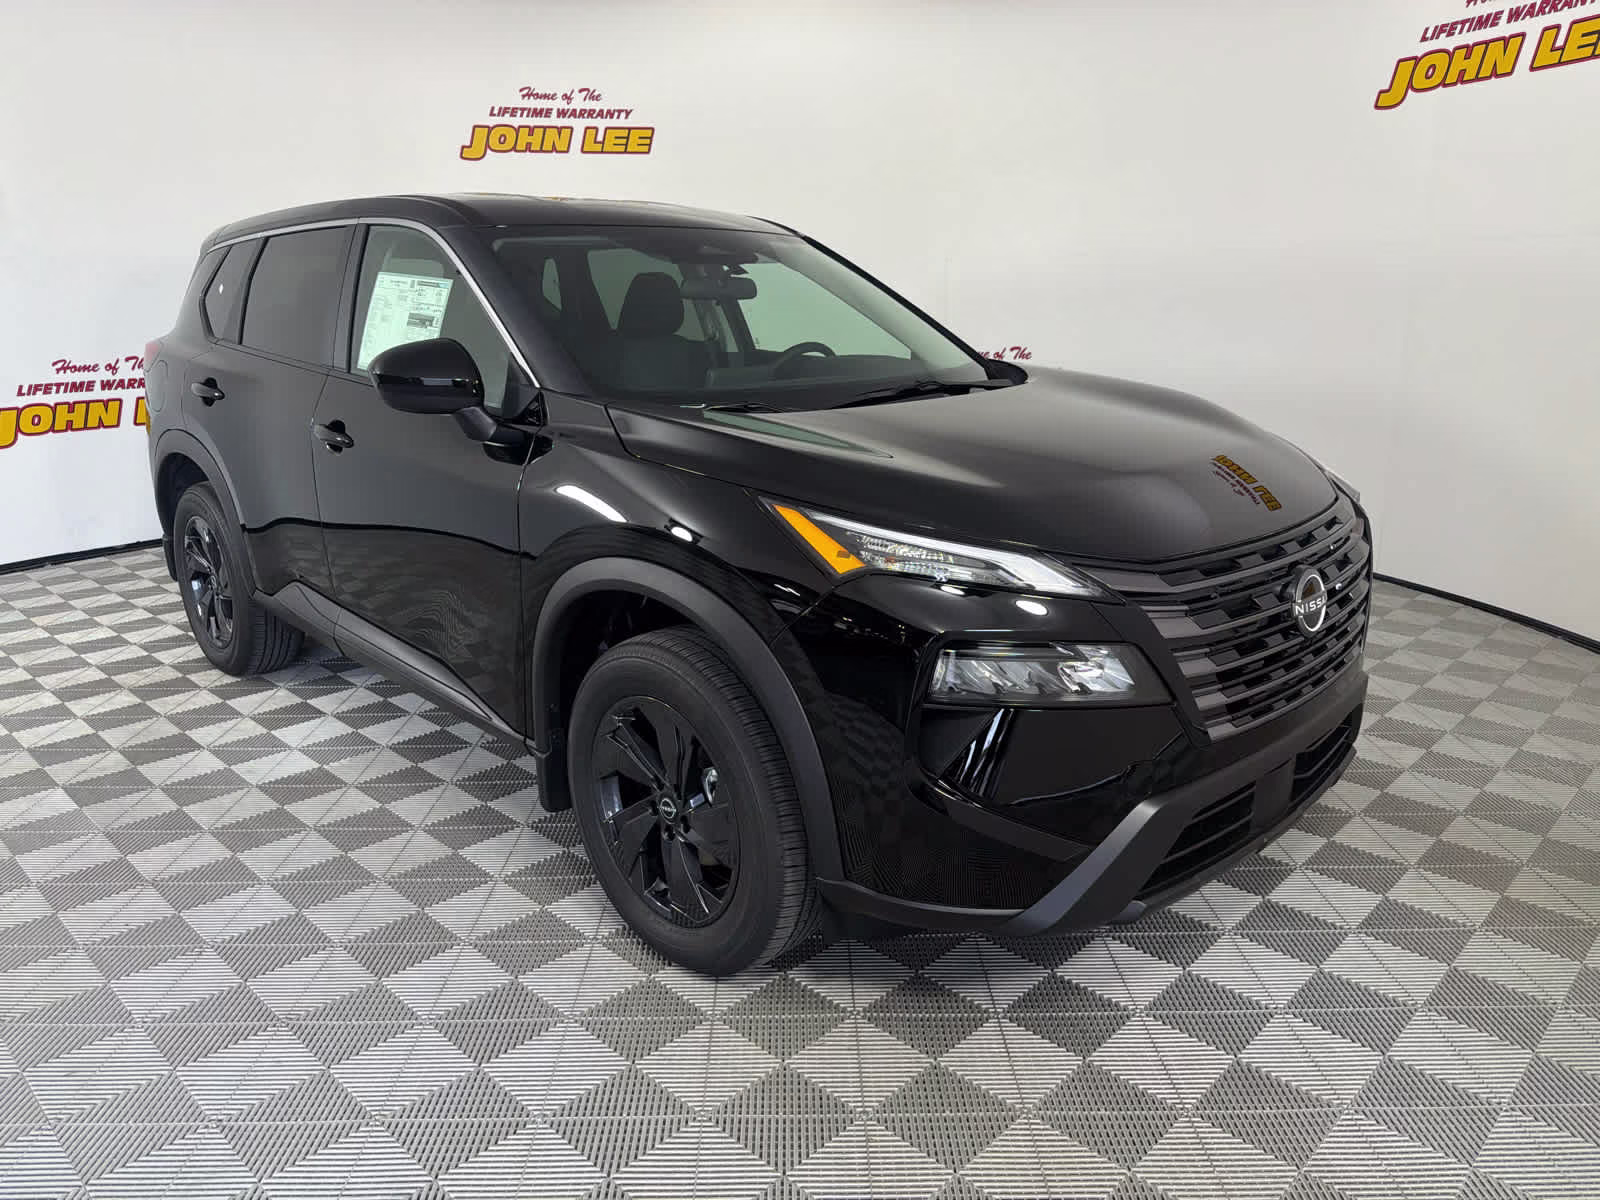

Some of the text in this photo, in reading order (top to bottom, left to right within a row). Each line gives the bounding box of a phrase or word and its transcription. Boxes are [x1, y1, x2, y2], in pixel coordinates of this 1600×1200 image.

[1419, 10, 1505, 43] LIFETIME
[1374, 13, 1600, 110] JOHN LE
[519, 86, 602, 105] Home of The
[489, 106, 633, 119] LIFETIME WARRANTY
[460, 124, 655, 161] JOHN LEE
[1010, 345, 1032, 360] The
[51, 356, 144, 376] Home of Th
[16, 377, 145, 397] LIFETIME WARR
[0, 398, 122, 449] JOHN
